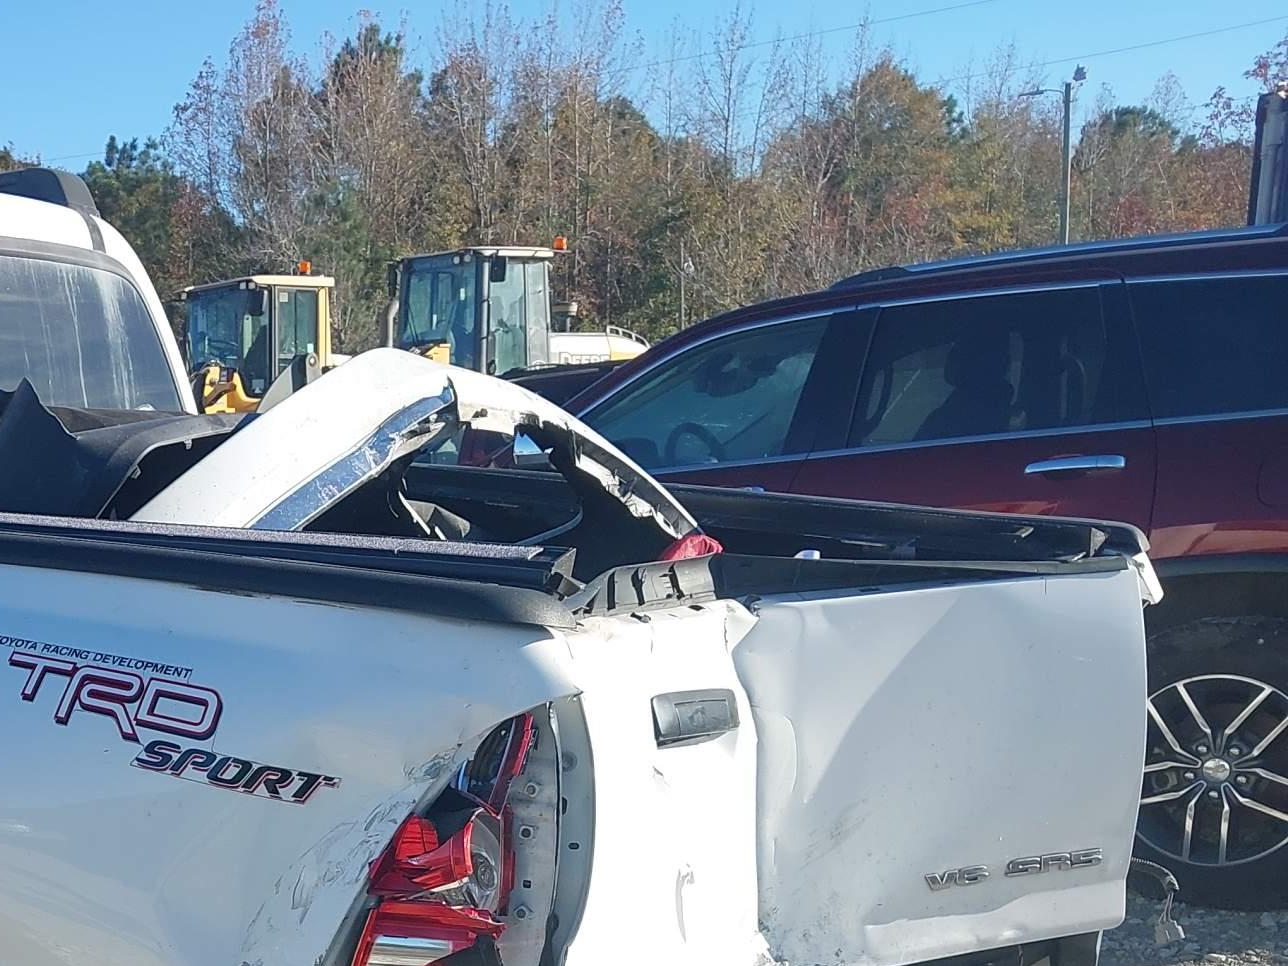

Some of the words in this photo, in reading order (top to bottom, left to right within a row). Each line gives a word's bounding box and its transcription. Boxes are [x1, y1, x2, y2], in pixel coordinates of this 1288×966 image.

[41, 642, 90, 660] RACING
[93, 651, 192, 679] DEVELOPMENT
[8, 651, 224, 742] TRD
[135, 740, 338, 804] SPORT
[924, 865, 990, 892] V6
[1004, 847, 1104, 878] SR5
